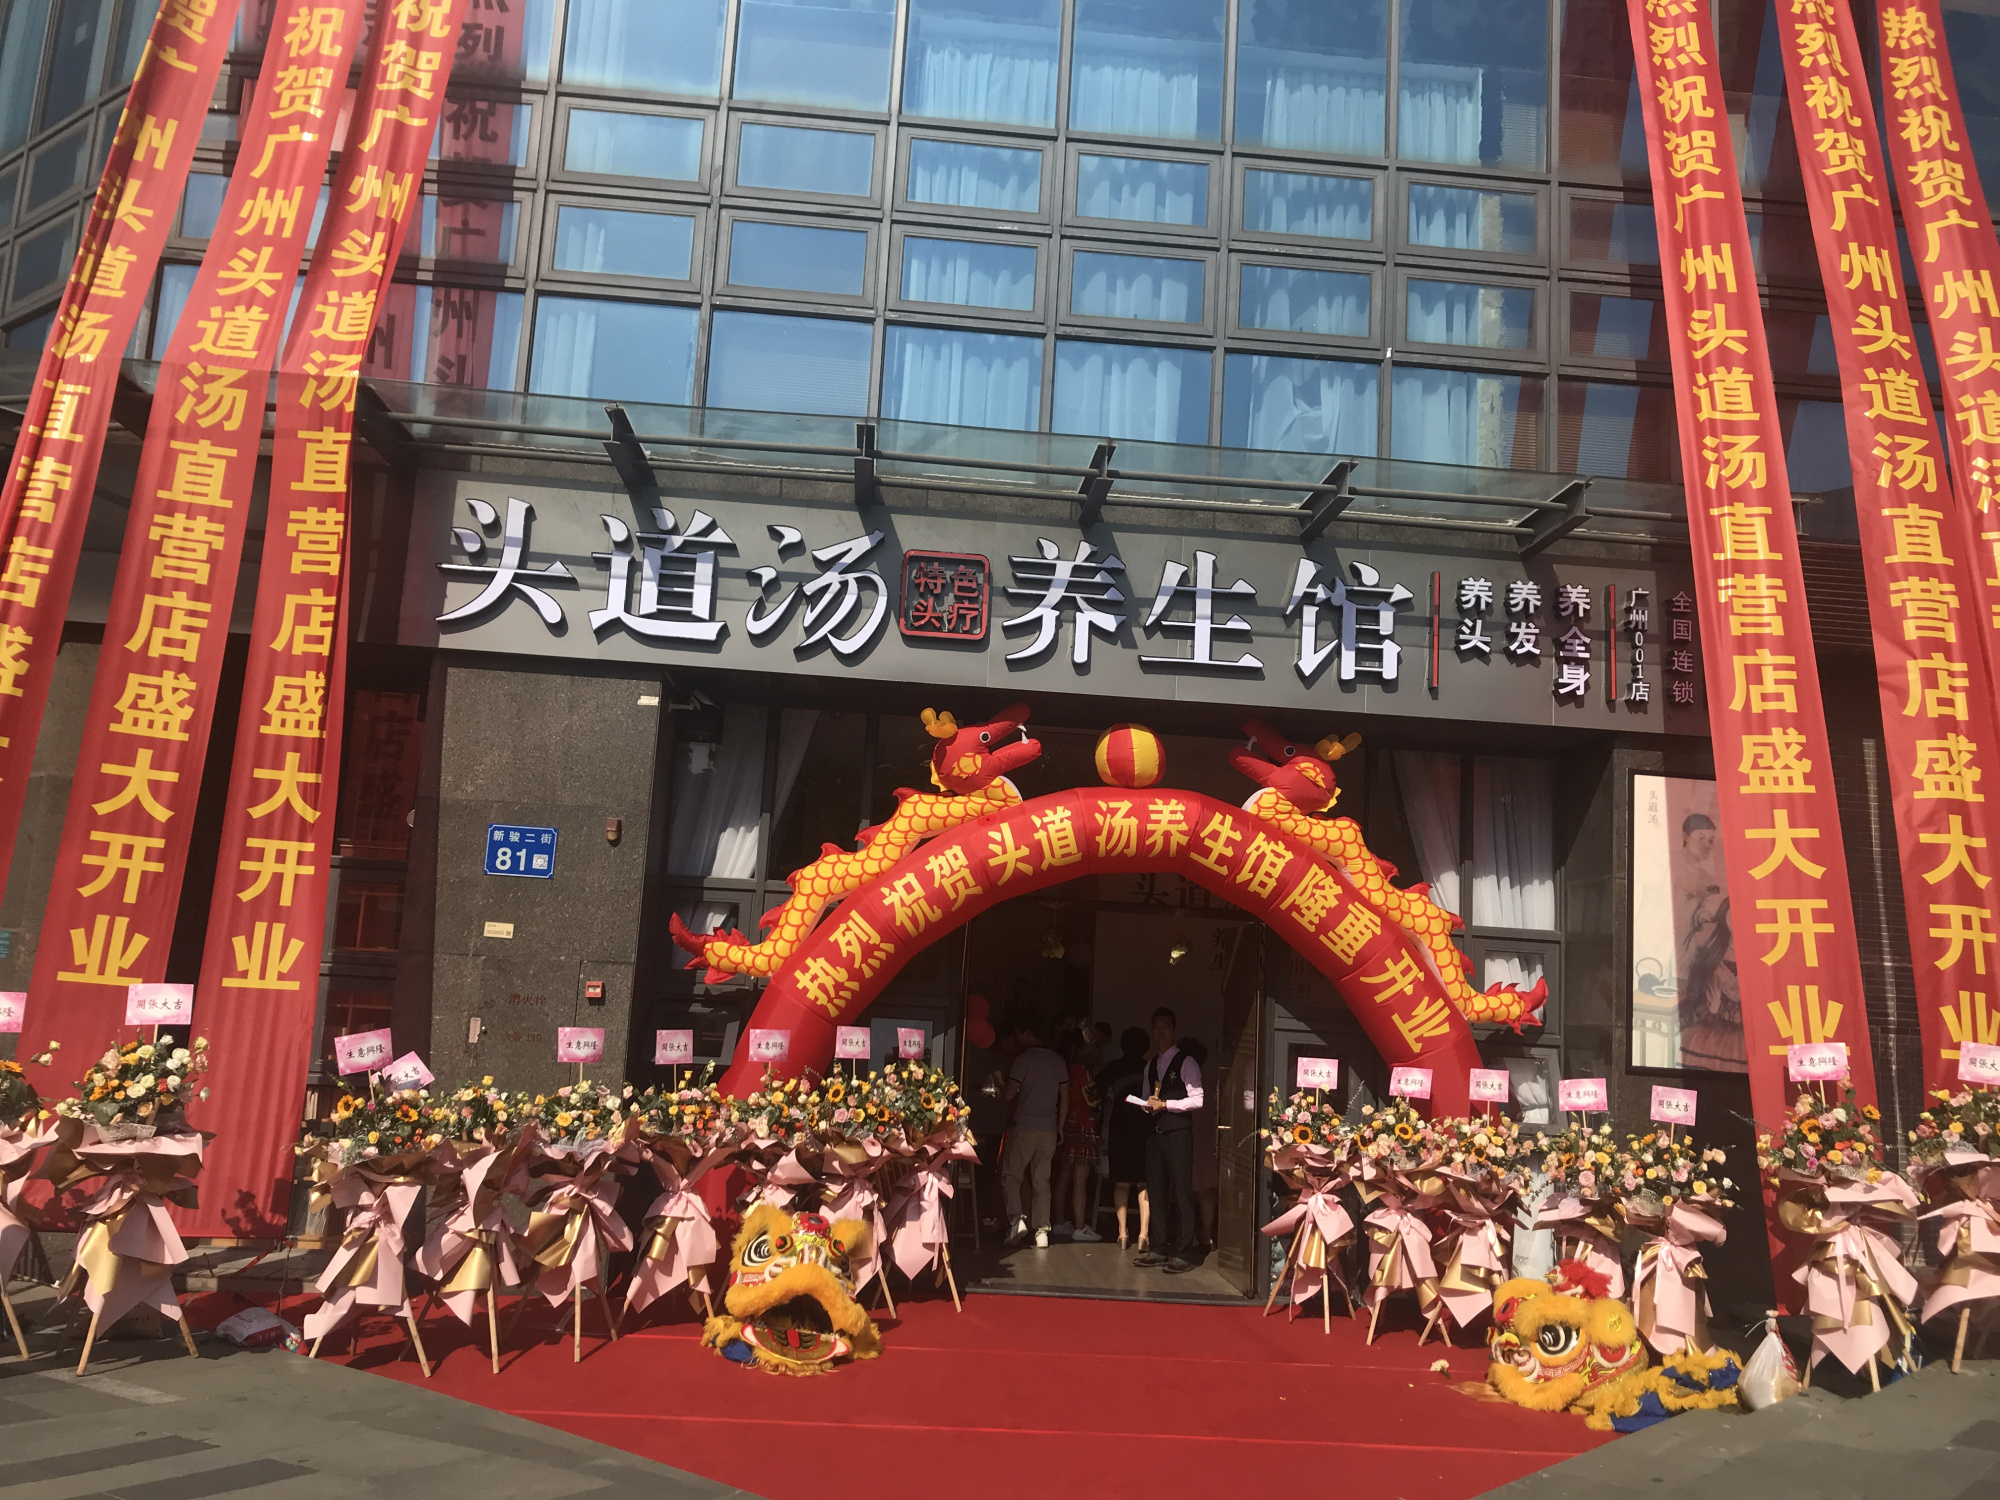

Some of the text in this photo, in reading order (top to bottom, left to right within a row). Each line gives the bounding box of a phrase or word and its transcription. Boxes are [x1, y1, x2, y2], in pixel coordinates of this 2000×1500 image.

[56, 7, 344, 986] 祝贺广州头道汤直营店盛大开业
[222, 0, 450, 990] 祝贺广州头道汤直营店盛大开业
[914, 562, 979, 597] 特色
[435, 496, 1413, 682] 头道汤 养生馆
[912, 595, 979, 631] 头疗
[1458, 575, 1494, 656] 养头
[1508, 580, 1542, 656] 养发
[1557, 583, 1592, 696] 养全身
[1629, 588, 1650, 702] 广州001店
[1671, 590, 1695, 704] 全国连锁
[493, 830, 553, 845] 新骏二街
[495, 847, 527, 871] 81
[795, 798, 1452, 1053] 热烈祝贺头道汤养生馆隆重开业
[136, 999, 183, 1011] 開張大吉
[508, 992, 547, 1006] 消火栓
[566, 1039, 599, 1051] 生意興隆
[661, 1041, 689, 1053] 開張大吉
[756, 1041, 785, 1051] 生意興隆
[841, 1038, 867, 1048] 開張大吉
[346, 1044, 386, 1060] 生意興隆
[1796, 1056, 1839, 1067] 生意興隆
[1302, 1068, 1332, 1079] 開張大吉
[1475, 1080, 1504, 1092] 開張大吉
[1565, 1088, 1600, 1100] 生意興隆
[1657, 1099, 1691, 1113] 開張大吉
